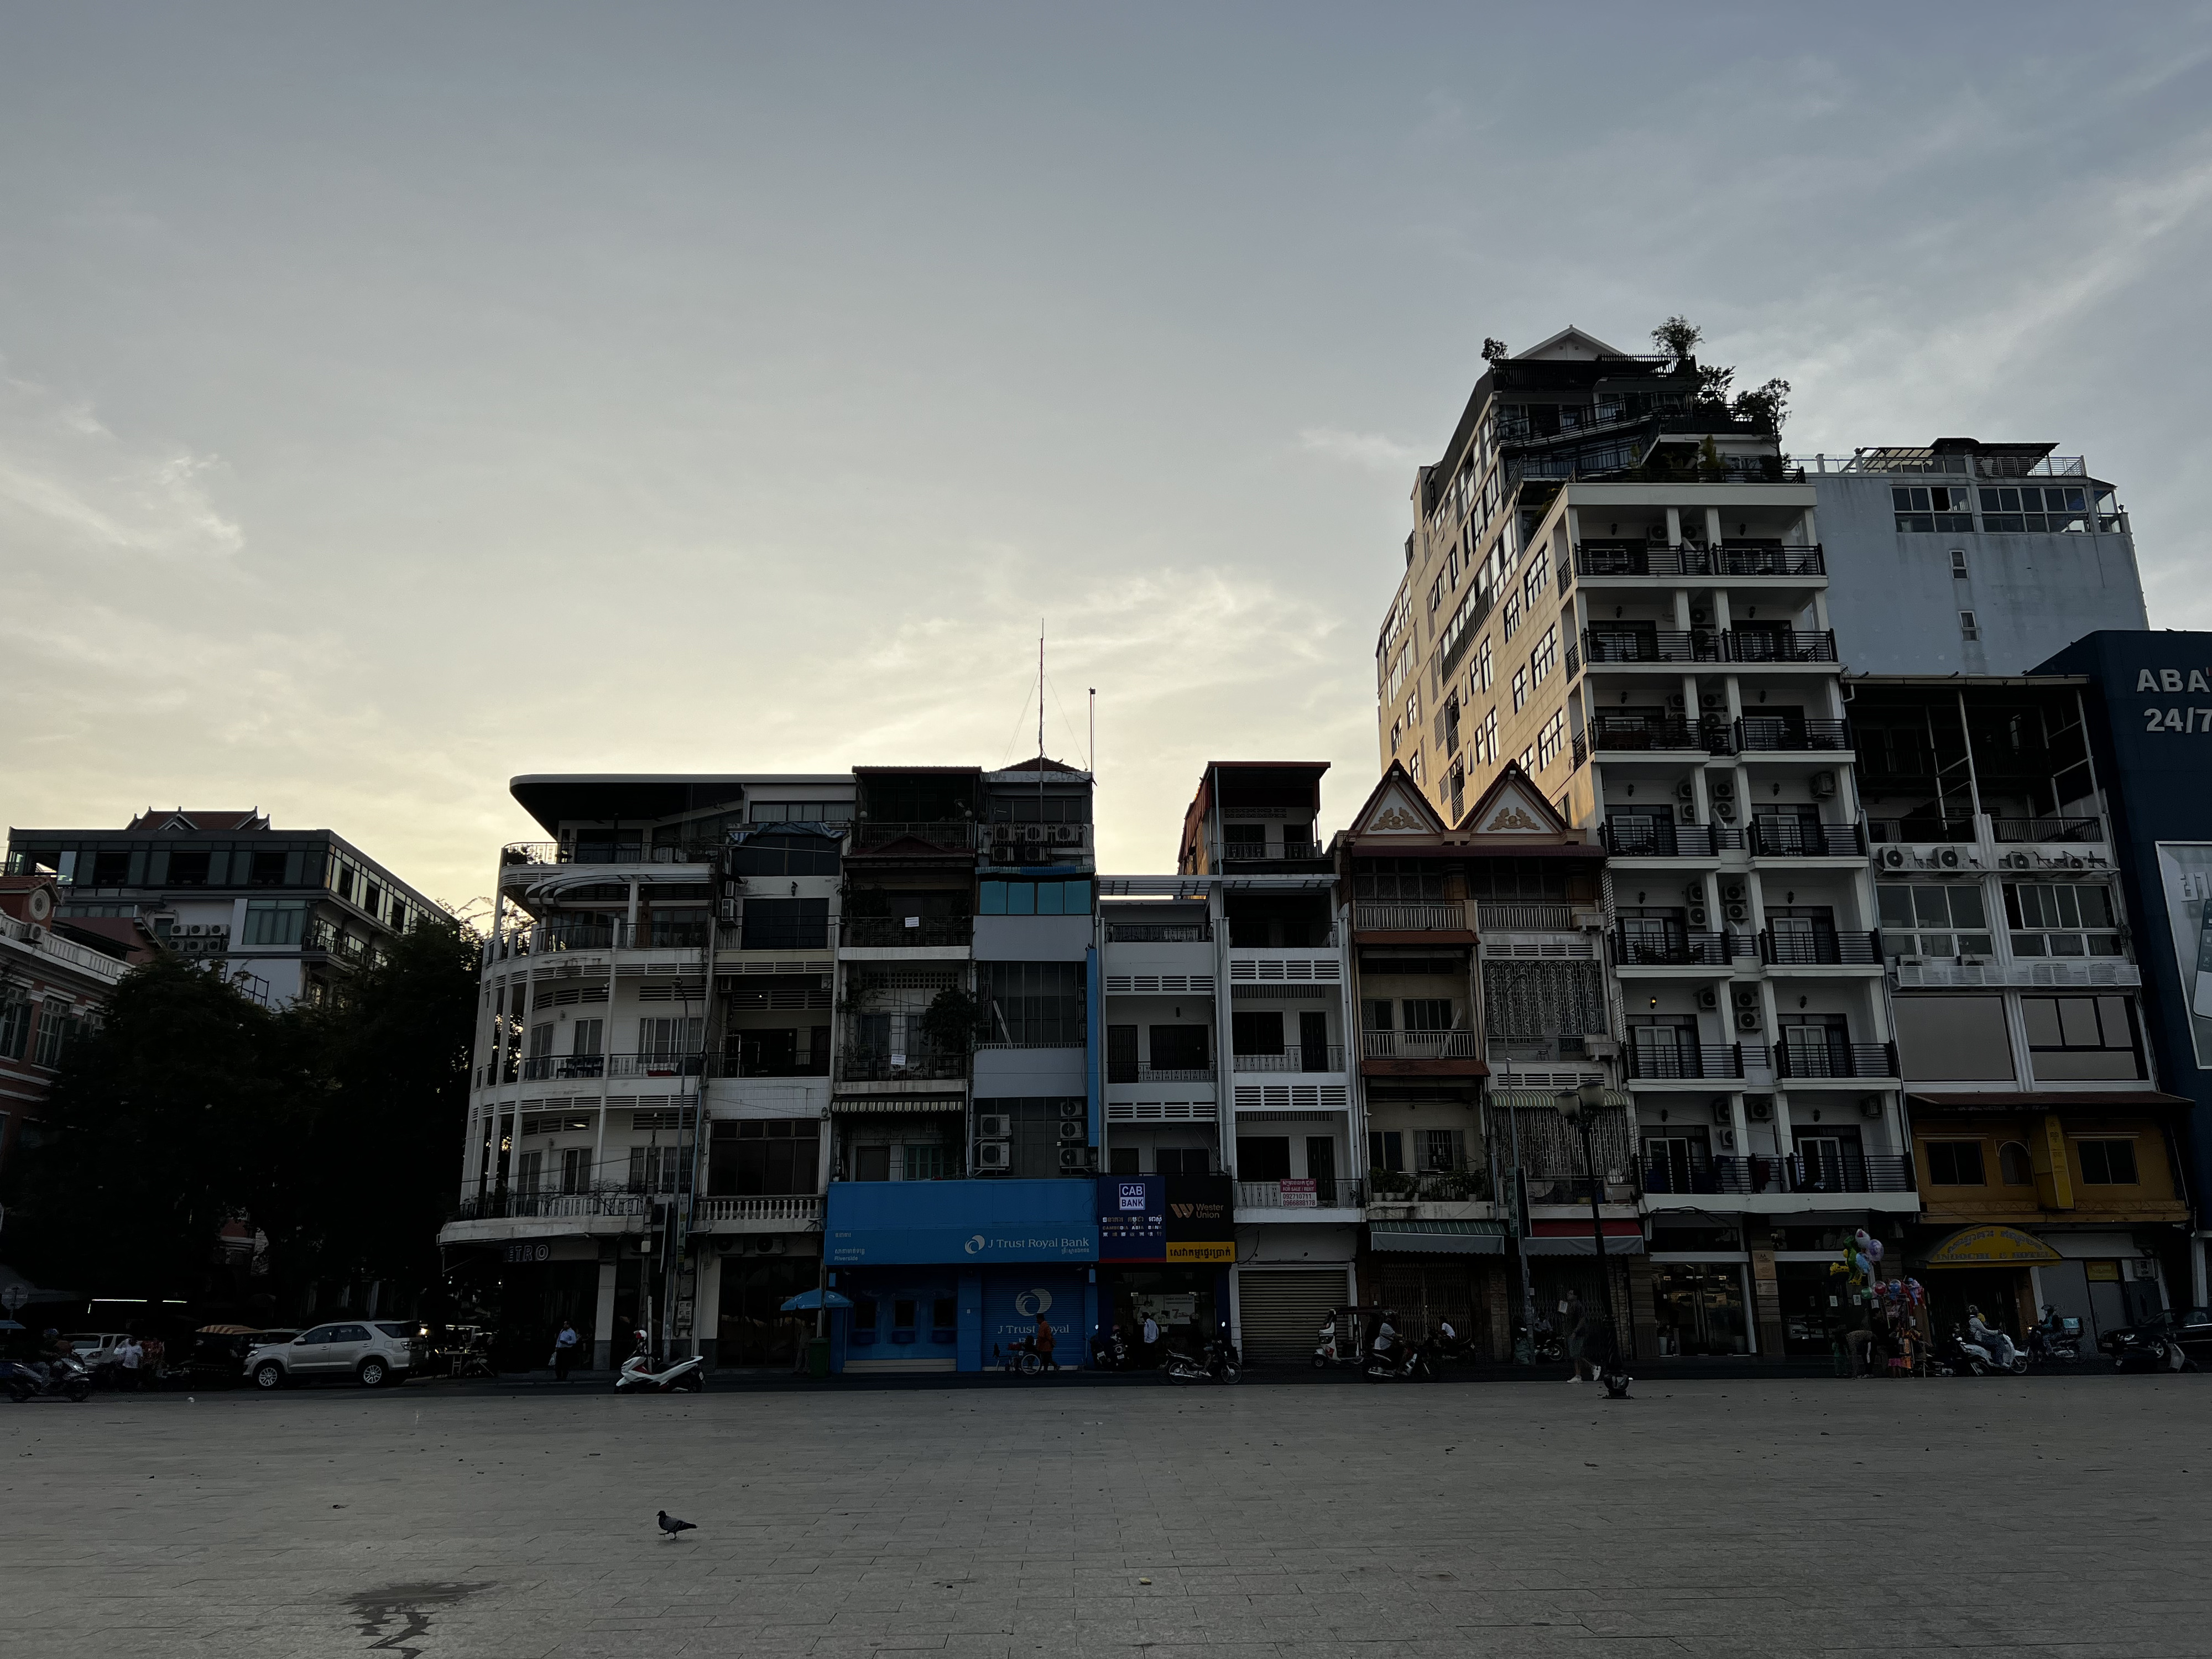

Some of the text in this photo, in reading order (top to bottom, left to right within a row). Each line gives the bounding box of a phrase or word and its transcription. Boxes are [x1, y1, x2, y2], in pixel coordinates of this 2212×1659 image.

[2137, 669, 2210, 692] ABA
[2144, 707, 2212, 733] 24/7
[1122, 1186, 1142, 1196] CAB
[988, 1237, 1089, 1249] J Trust Royal Bank
[998, 1326, 1003, 1334] J
[1006, 1325, 1035, 1334] Trust
